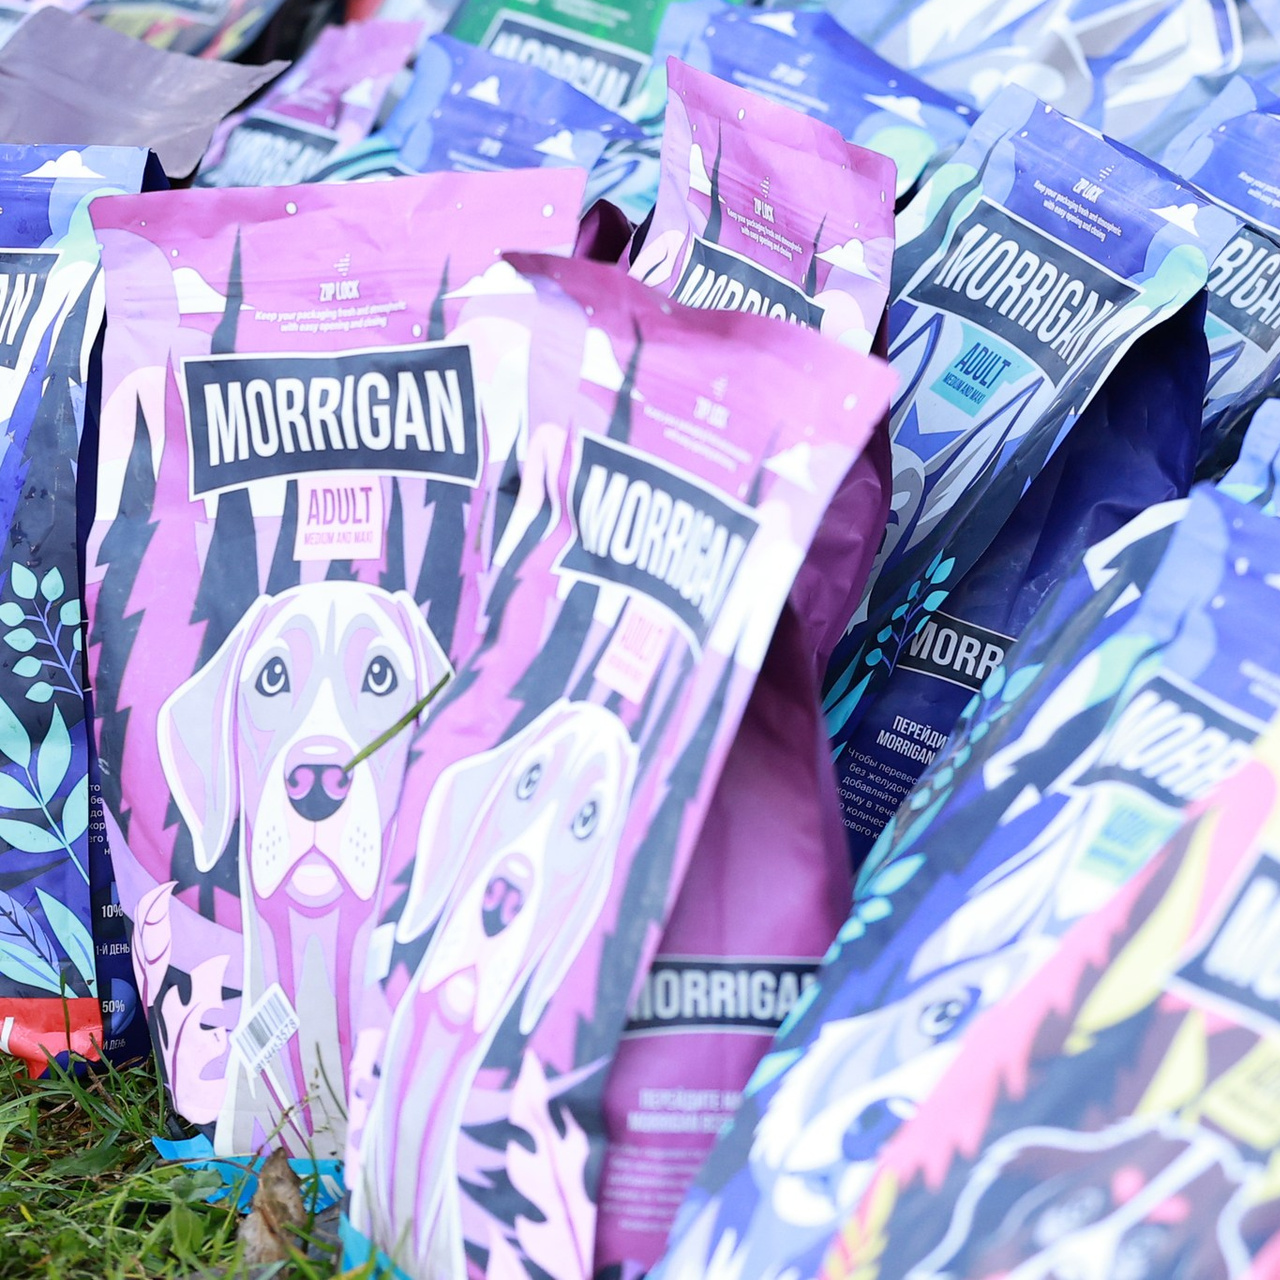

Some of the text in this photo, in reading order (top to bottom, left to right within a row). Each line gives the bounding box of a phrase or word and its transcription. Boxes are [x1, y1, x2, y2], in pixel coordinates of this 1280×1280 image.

[933, 222, 1121, 365] MORRIGAN
[954, 342, 1012, 389] ADULT
[203, 369, 465, 468] MORRIGAN
[307, 486, 373, 526] ADULT
[876, 729, 936, 766] MORRIGAN
[892, 715, 948, 750] ПЕРЕЙДИ
[849, 763, 866, 777] без
[879, 762, 918, 786] перевес
[842, 776, 898, 806] добавляйте
[101, 903, 124, 918] 10%
[96, 942, 131, 956] 1-Й ДЕНЬ
[102, 1000, 125, 1013] 50%
[109, 1038, 126, 1051] ДЕНЬ
